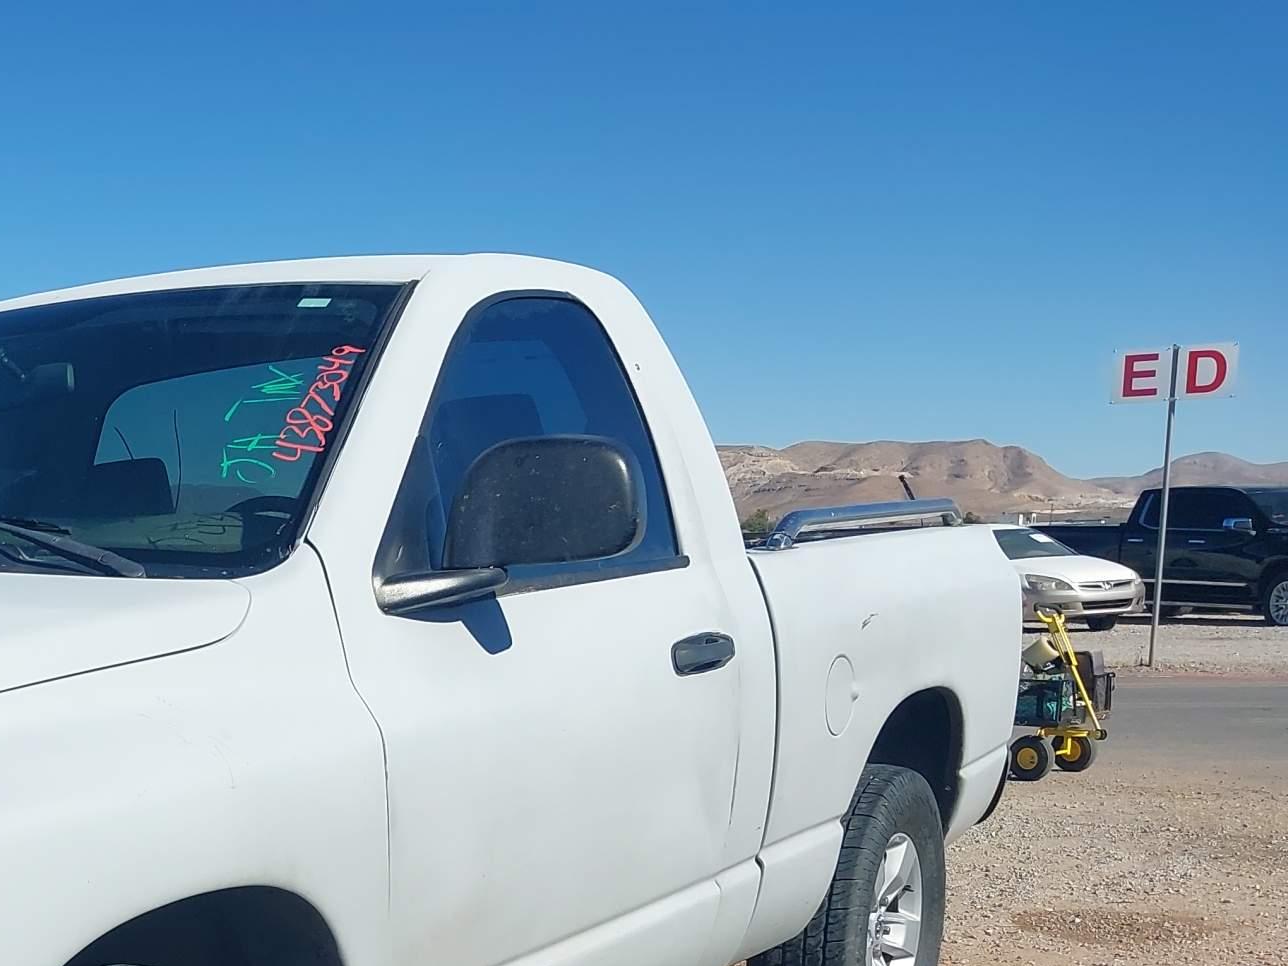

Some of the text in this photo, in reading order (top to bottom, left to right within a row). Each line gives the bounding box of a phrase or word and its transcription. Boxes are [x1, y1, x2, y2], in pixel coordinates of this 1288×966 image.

[271, 344, 367, 462] 43873049
[1121, 349, 1228, 398] E D
